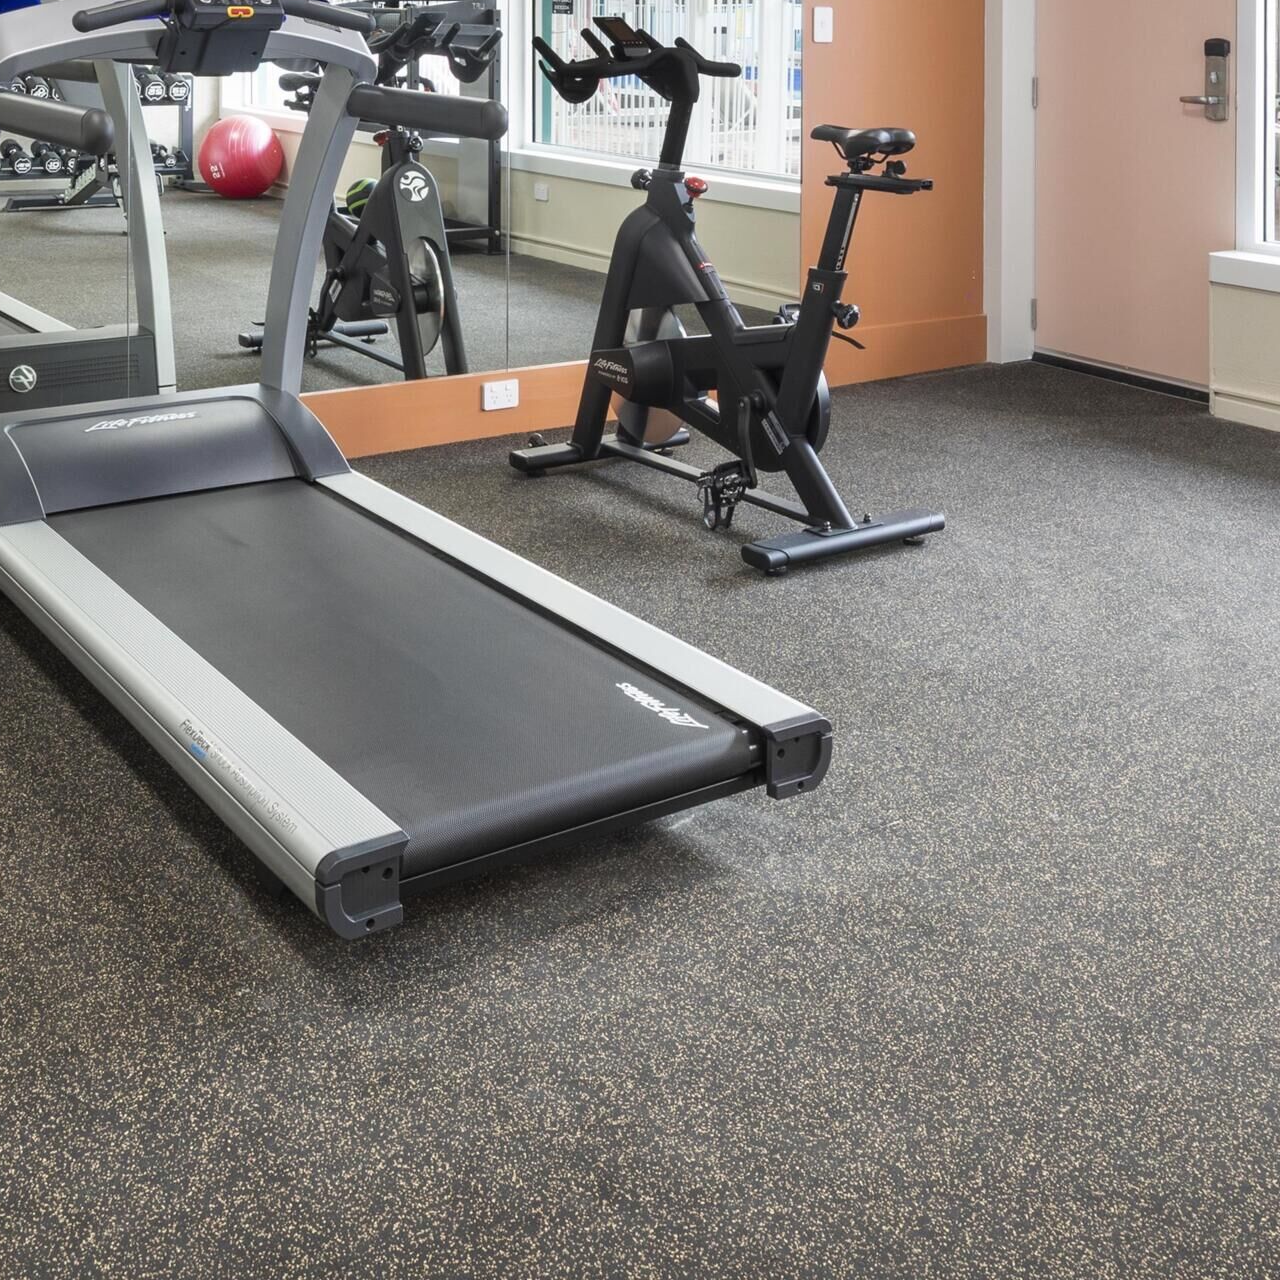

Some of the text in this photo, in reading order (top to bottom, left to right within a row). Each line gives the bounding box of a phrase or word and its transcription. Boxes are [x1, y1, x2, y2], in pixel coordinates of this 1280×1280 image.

[84, 411, 198, 433] Life Fitness
[615, 682, 710, 729] Life Fitness
[267, 800, 298, 835] System
